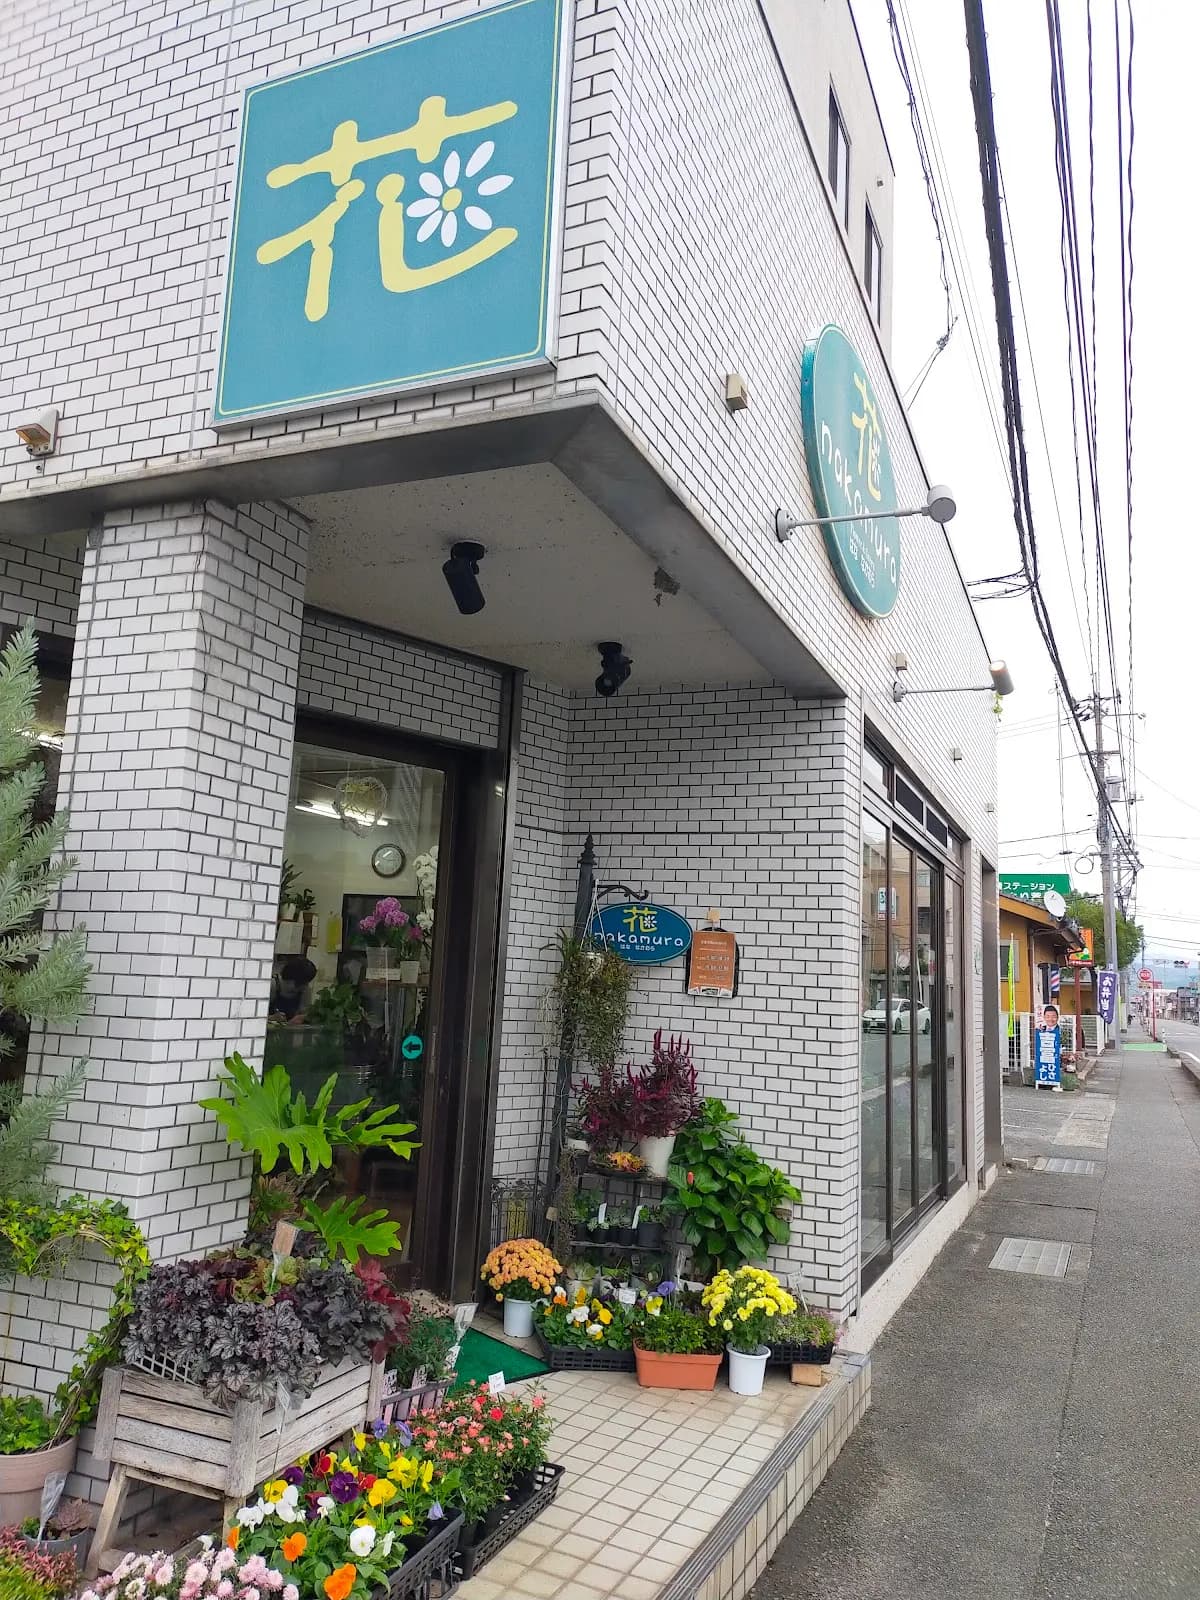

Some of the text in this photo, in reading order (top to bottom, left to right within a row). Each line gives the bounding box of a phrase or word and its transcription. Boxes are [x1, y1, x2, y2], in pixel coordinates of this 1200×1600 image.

[256, 95, 518, 322] 花
[852, 371, 882, 501] 花
[821, 420, 897, 588] nakamura
[594, 931, 684, 947] nakamura
[622, 906, 658, 933] 花
